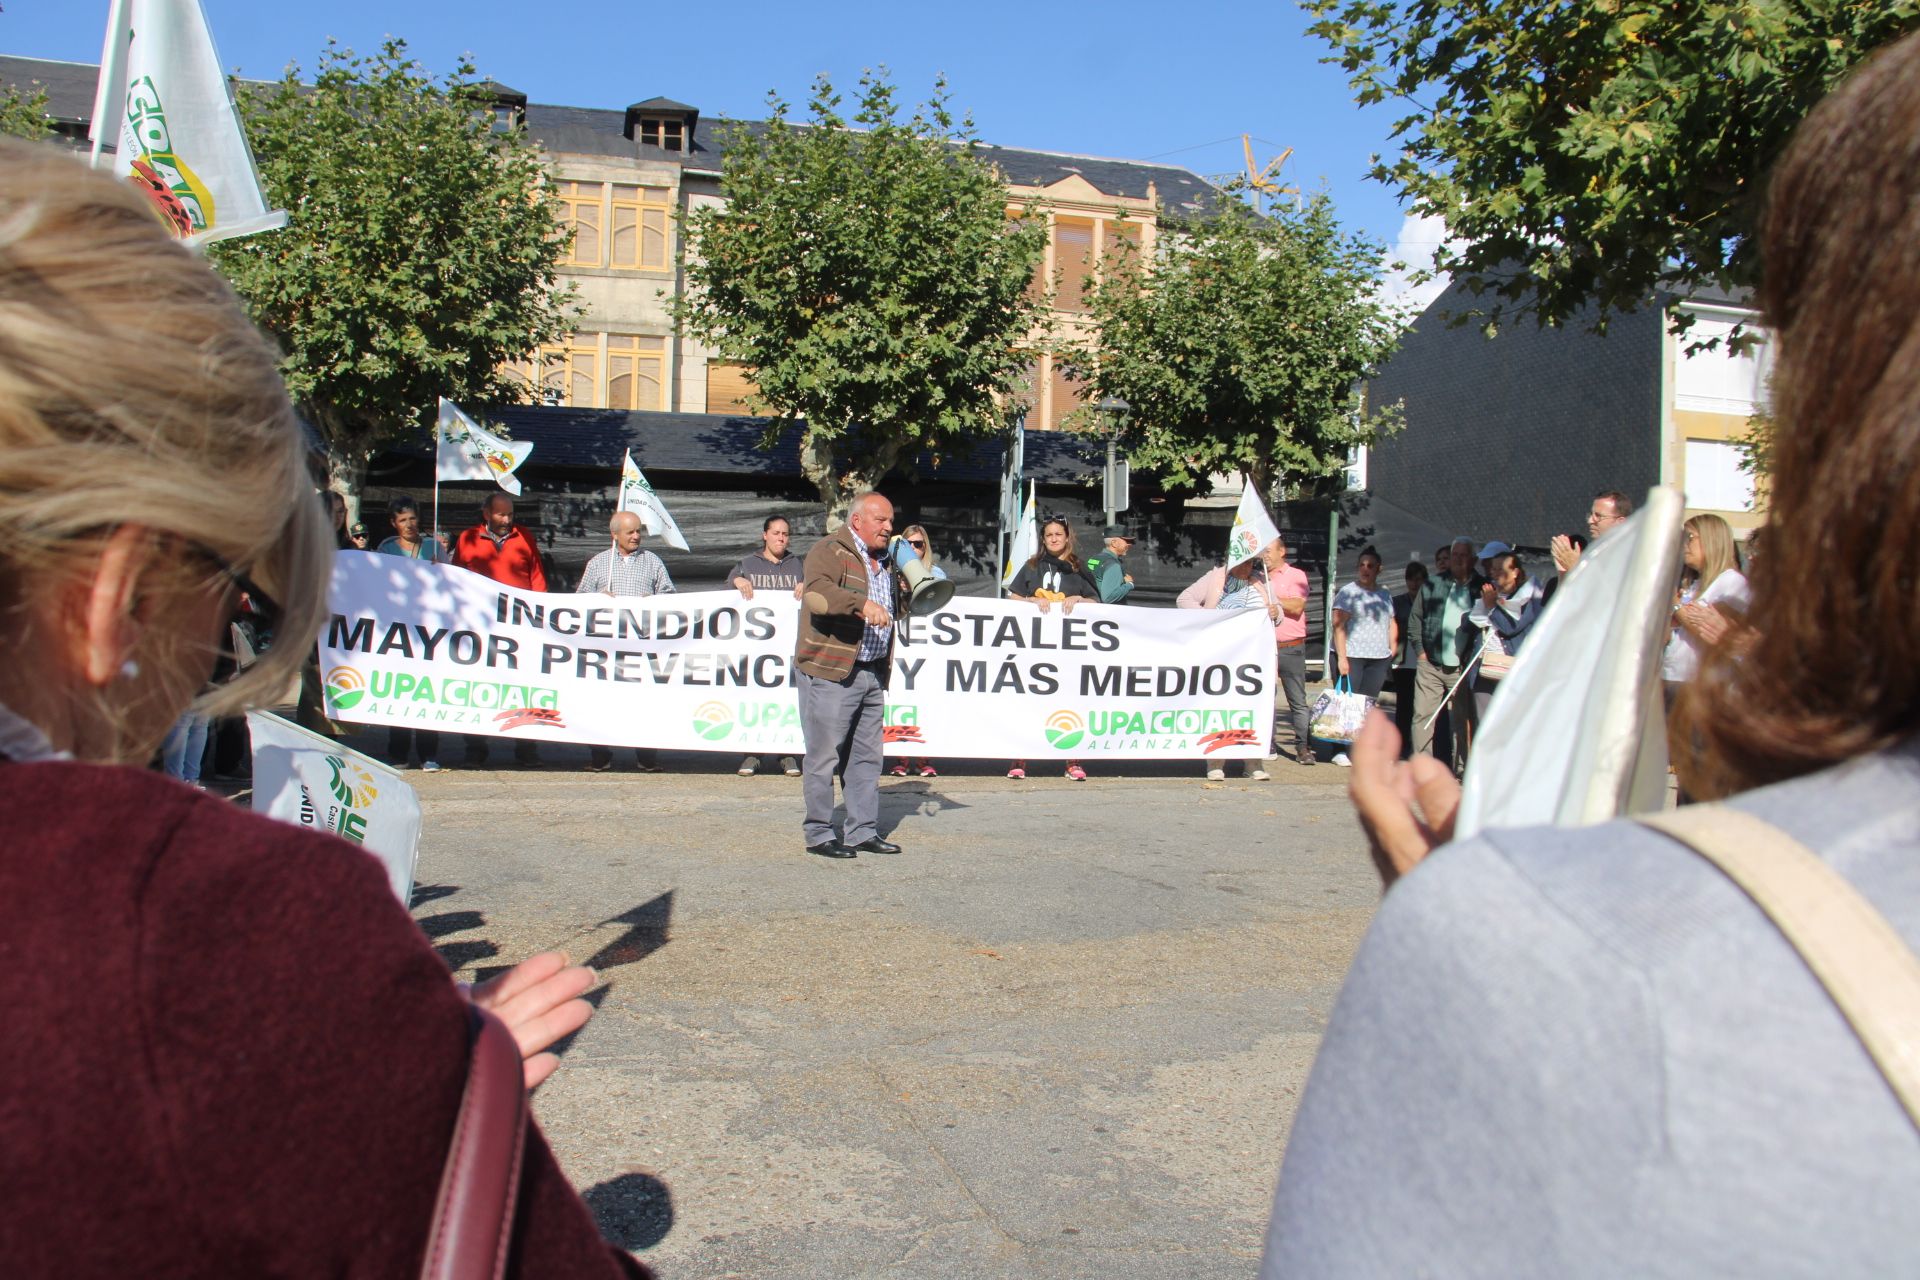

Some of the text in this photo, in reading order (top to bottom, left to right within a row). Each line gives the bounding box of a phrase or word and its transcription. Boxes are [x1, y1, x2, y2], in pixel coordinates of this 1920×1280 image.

[750, 573, 798, 588] NIRVANA
[496, 593, 1120, 651] INCENDIOS ESTALES
[327, 614, 1264, 697] MAYOR PREVENCI Y MÁS MEDIOS
[369, 669, 558, 711] UPA COAG
[367, 702, 482, 725] ALIANZA
[1088, 709, 1254, 736] UPA COAG
[738, 731, 806, 745] ALIA
[1087, 739, 1188, 751] ALIANZA
[301, 785, 313, 824] UNID
